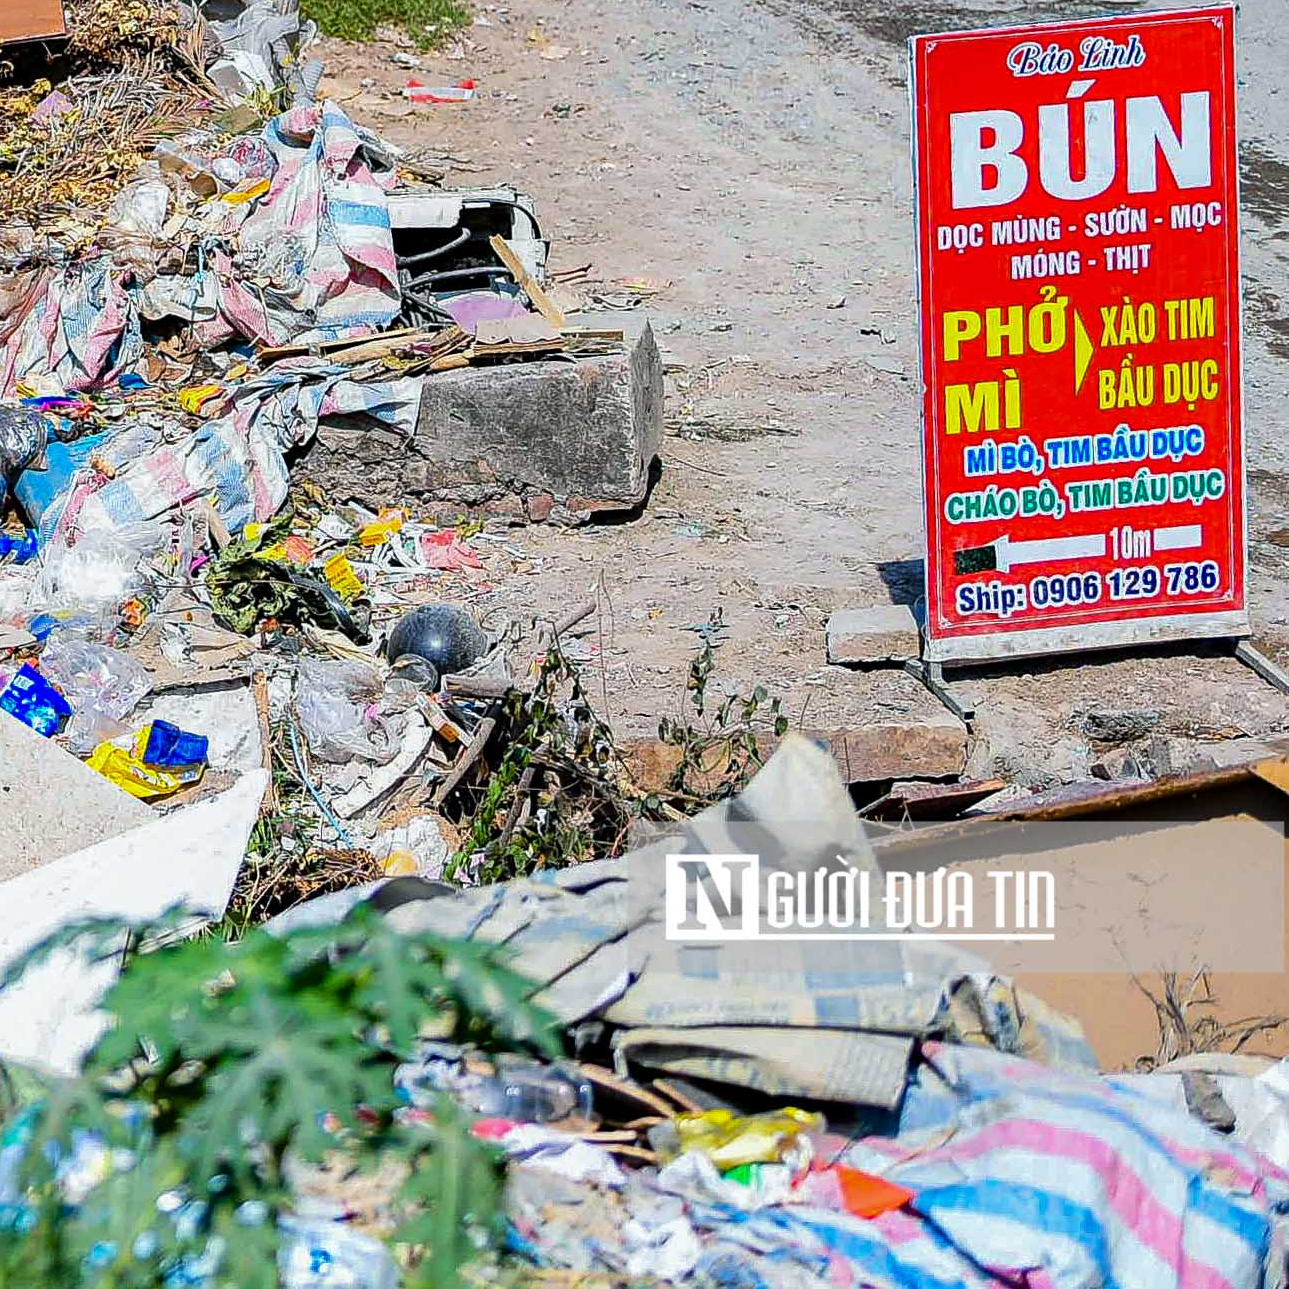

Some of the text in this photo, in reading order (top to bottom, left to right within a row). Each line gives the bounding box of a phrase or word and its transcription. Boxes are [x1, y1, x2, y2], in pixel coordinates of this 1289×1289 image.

[1080, 35, 1145, 71] Linh
[949, 78, 1211, 209] BÚN
[937, 223, 983, 252] DỌC
[992, 215, 1061, 246] MÙNG
[1085, 204, 1147, 237] SƯỜN
[1171, 202, 1222, 232] MỌC
[1011, 248, 1081, 280] MÓNG
[1104, 244, 1152, 274] THỊT
[943, 285, 1069, 362] PHỞ
[1100, 296, 1215, 347] XÀO TIM
[945, 369, 1022, 435] MÌ
[1099, 353, 1219, 411] BẦU DỤC
[966, 424, 1205, 475] MÌ BÒ, TIM BẦU DỤC
[947, 468, 1224, 523] CHÁO BÒ, TIM BẦU DỤC
[1109, 526, 1151, 560] 10m
[957, 563, 1219, 617] Ship: 0906 129 786
